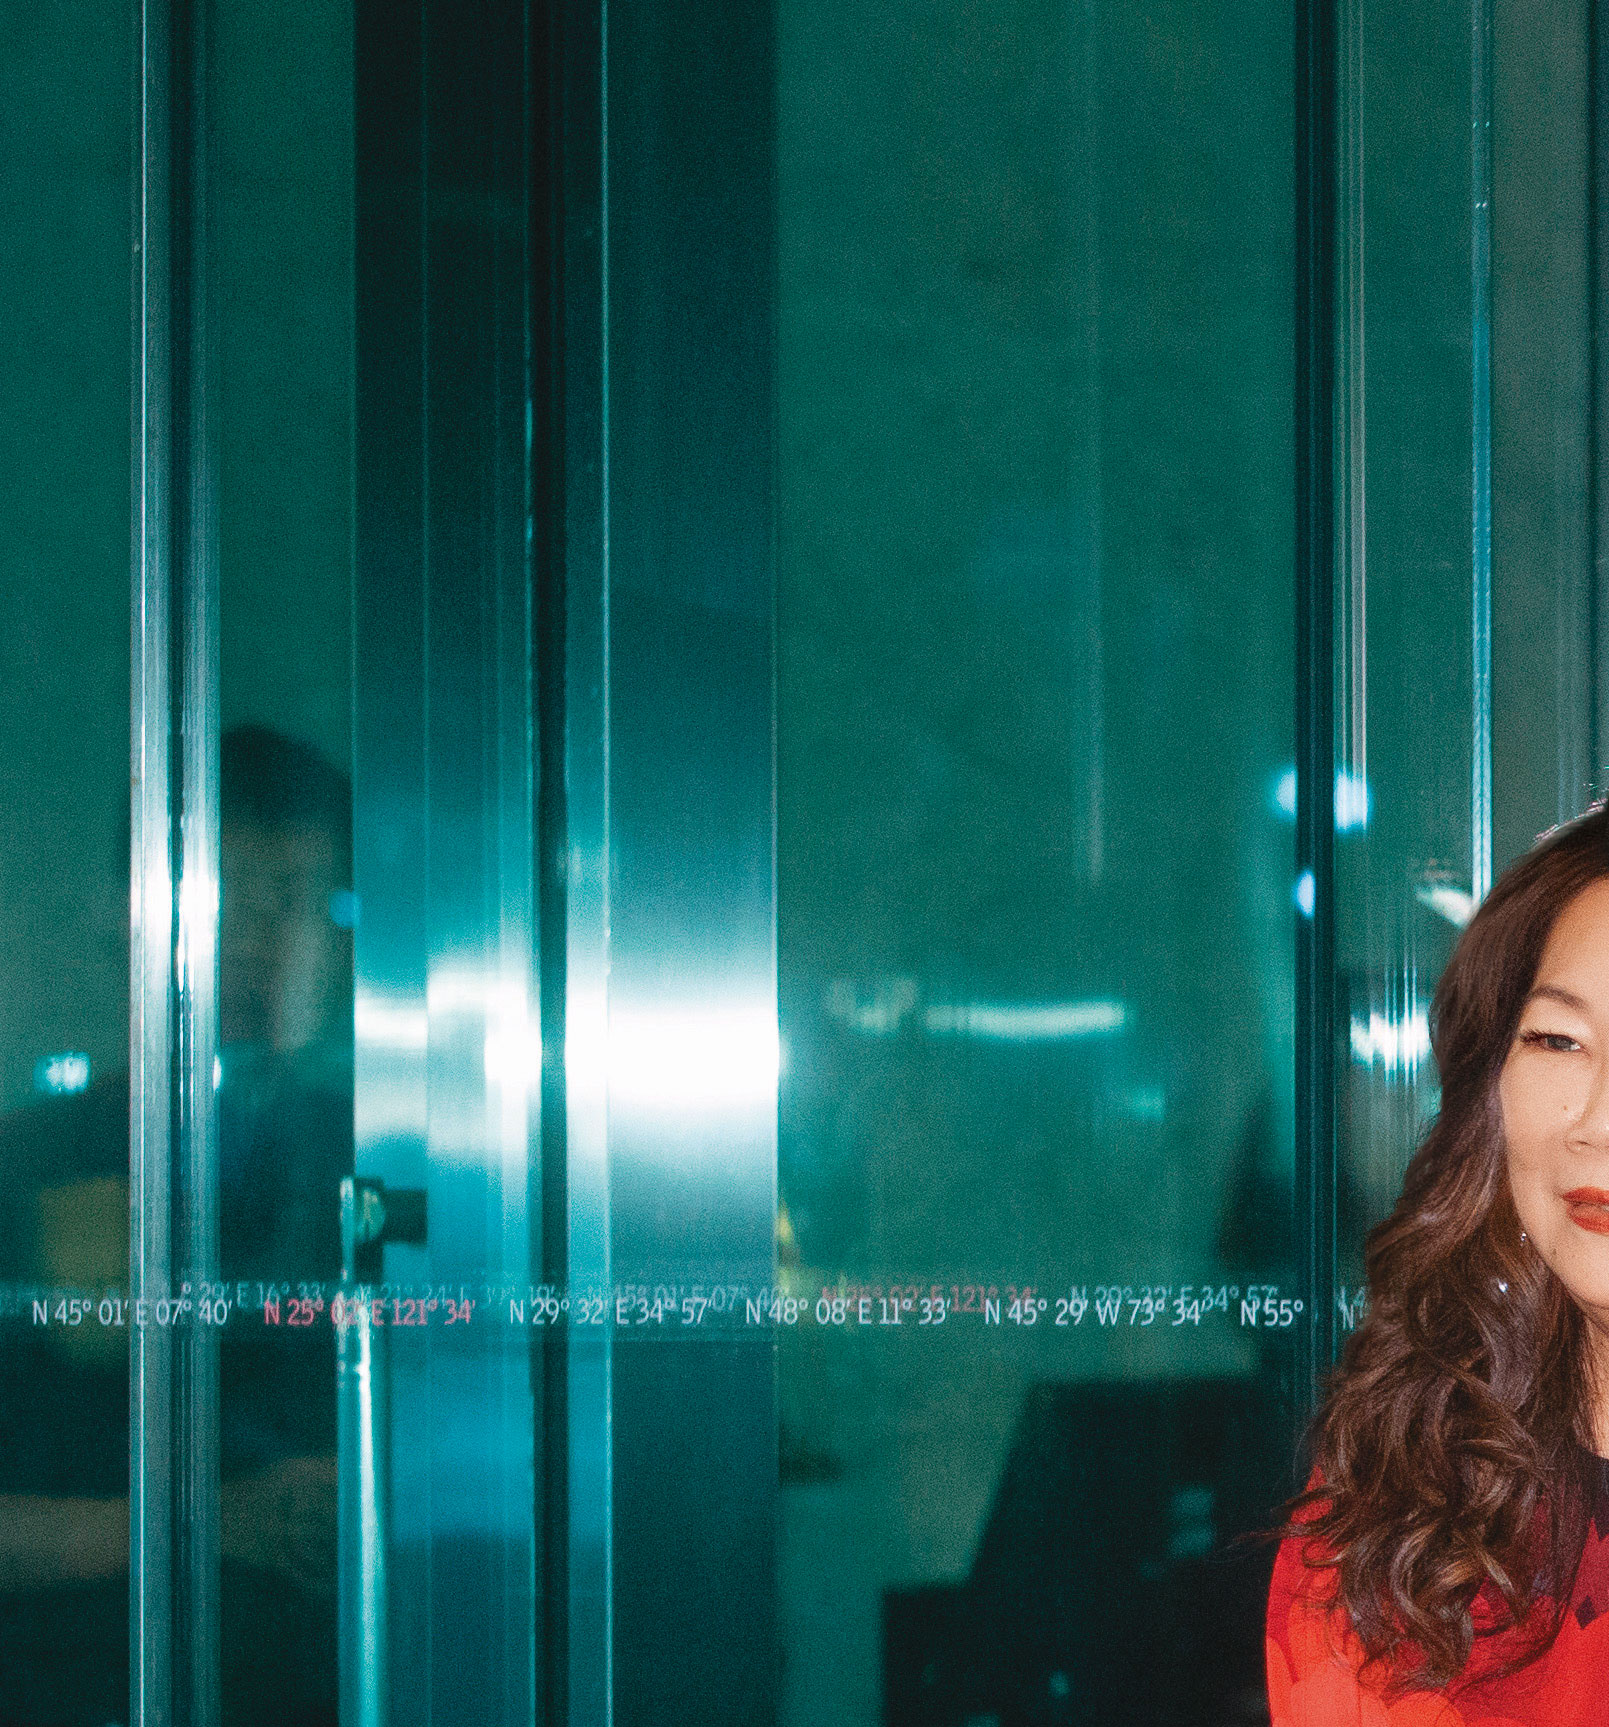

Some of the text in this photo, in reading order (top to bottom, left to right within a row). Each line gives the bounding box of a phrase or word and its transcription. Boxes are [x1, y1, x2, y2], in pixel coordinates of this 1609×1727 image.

[237, 1282, 249, 1308] E
[32, 1298, 47, 1325] N
[55, 1298, 92, 1325] 45°
[99, 1298, 129, 1325] 01'
[136, 1298, 149, 1325] E
[156, 1298, 192, 1325] 07°
[200, 1298, 232, 1325] 40'
[264, 1298, 280, 1325] N
[371, 1298, 385, 1325] E
[444, 1298, 476, 1325] 34'
[510, 1298, 524, 1325] N
[532, 1298, 570, 1325] 29°
[616, 1298, 630, 1325] E
[681, 1298, 712, 1325] 57'
[745, 1298, 761, 1325] N
[769, 1298, 809, 1325] 48°
[816, 1298, 851, 1325] 08'
[858, 1298, 872, 1325] E
[919, 1298, 951, 1325] 33'
[985, 1298, 1000, 1325] N
[1008, 1298, 1047, 1325] 45°
[1055, 1298, 1089, 1325] 29'
[1095, 1298, 1122, 1325] W
[1172, 1298, 1205, 1325] 34'
[1241, 1299, 1256, 1327] N
[1264, 1299, 1304, 1327] 55°
